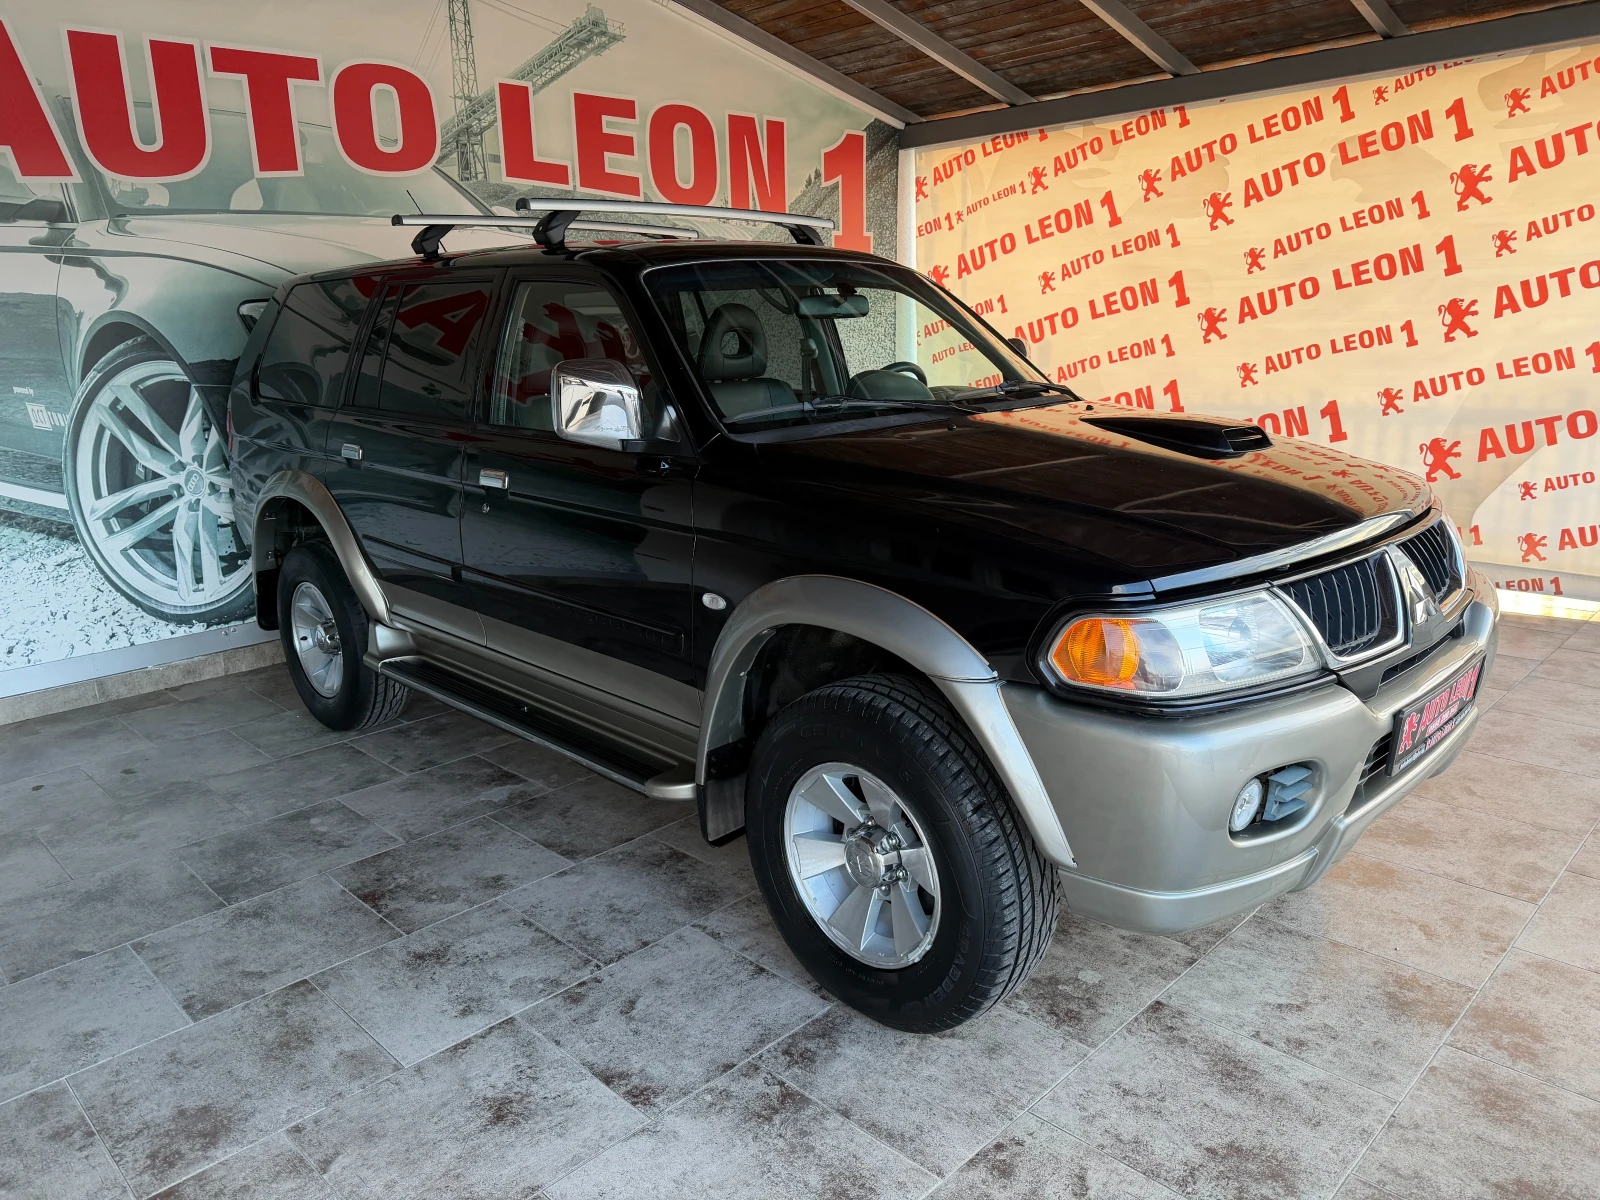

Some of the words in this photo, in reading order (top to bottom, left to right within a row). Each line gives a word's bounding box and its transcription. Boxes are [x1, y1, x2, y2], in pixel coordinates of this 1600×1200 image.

[1394, 64, 1437, 94] AUTO
[1053, 137, 1104, 178] AUTO
[1109, 108, 1168, 147] LEON
[1173, 105, 1191, 129] 1
[1170, 132, 1238, 183] AUTO
[1246, 95, 1325, 145] LEON
[1331, 85, 1356, 124] 1
[1243, 151, 1326, 209] AUTO
[1337, 109, 1434, 166] LEON
[1444, 96, 1475, 143] 1
[1508, 120, 1600, 183] AUT
[498, 81, 788, 213] LEON
[822, 131, 873, 254] 1
[933, 148, 976, 187] AUTO
[916, 216, 942, 240] EON
[944, 211, 955, 232] 1
[966, 197, 990, 217] AUTO
[992, 184, 1018, 202] LEON
[1018, 180, 1027, 195] 1
[1273, 222, 1332, 260] AUTO
[1339, 197, 1405, 233] LEON
[1410, 189, 1431, 220] 1
[1525, 203, 1595, 242] AUTO
[957, 232, 1017, 280] AUTO
[1024, 198, 1094, 246] LEON
[1099, 190, 1123, 229] 1
[1061, 249, 1105, 282] AUTO
[1111, 228, 1161, 259] LEON
[1165, 223, 1181, 249] 1
[997, 294, 1008, 314] 1
[1014, 306, 1079, 344] AUTO
[1088, 277, 1160, 320] LEON
[1167, 269, 1191, 308] 1
[1238, 276, 1321, 325] AUTO
[1331, 243, 1425, 291] LEON
[1435, 234, 1463, 277] 1
[1493, 259, 1600, 319] AUTO
[932, 346, 956, 364] AUTO
[1057, 354, 1101, 384] AUTO
[1107, 337, 1157, 365] LEON
[1160, 333, 1176, 358] 1
[1265, 343, 1322, 375] AUTO
[1329, 324, 1393, 355] LEON
[1400, 319, 1419, 348] 1
[1413, 367, 1486, 403] AUTO
[1495, 346, 1576, 380] LEON
[1584, 340, 1600, 374] 1
[1162, 379, 1185, 413] 1
[1319, 399, 1348, 443] 1
[1477, 409, 1599, 463] AUTO
[1544, 471, 1595, 492] AUTO
[1469, 525, 1483, 546] 1
[1549, 576, 1563, 596] 1
[1414, 689, 1450, 743] AUTO
